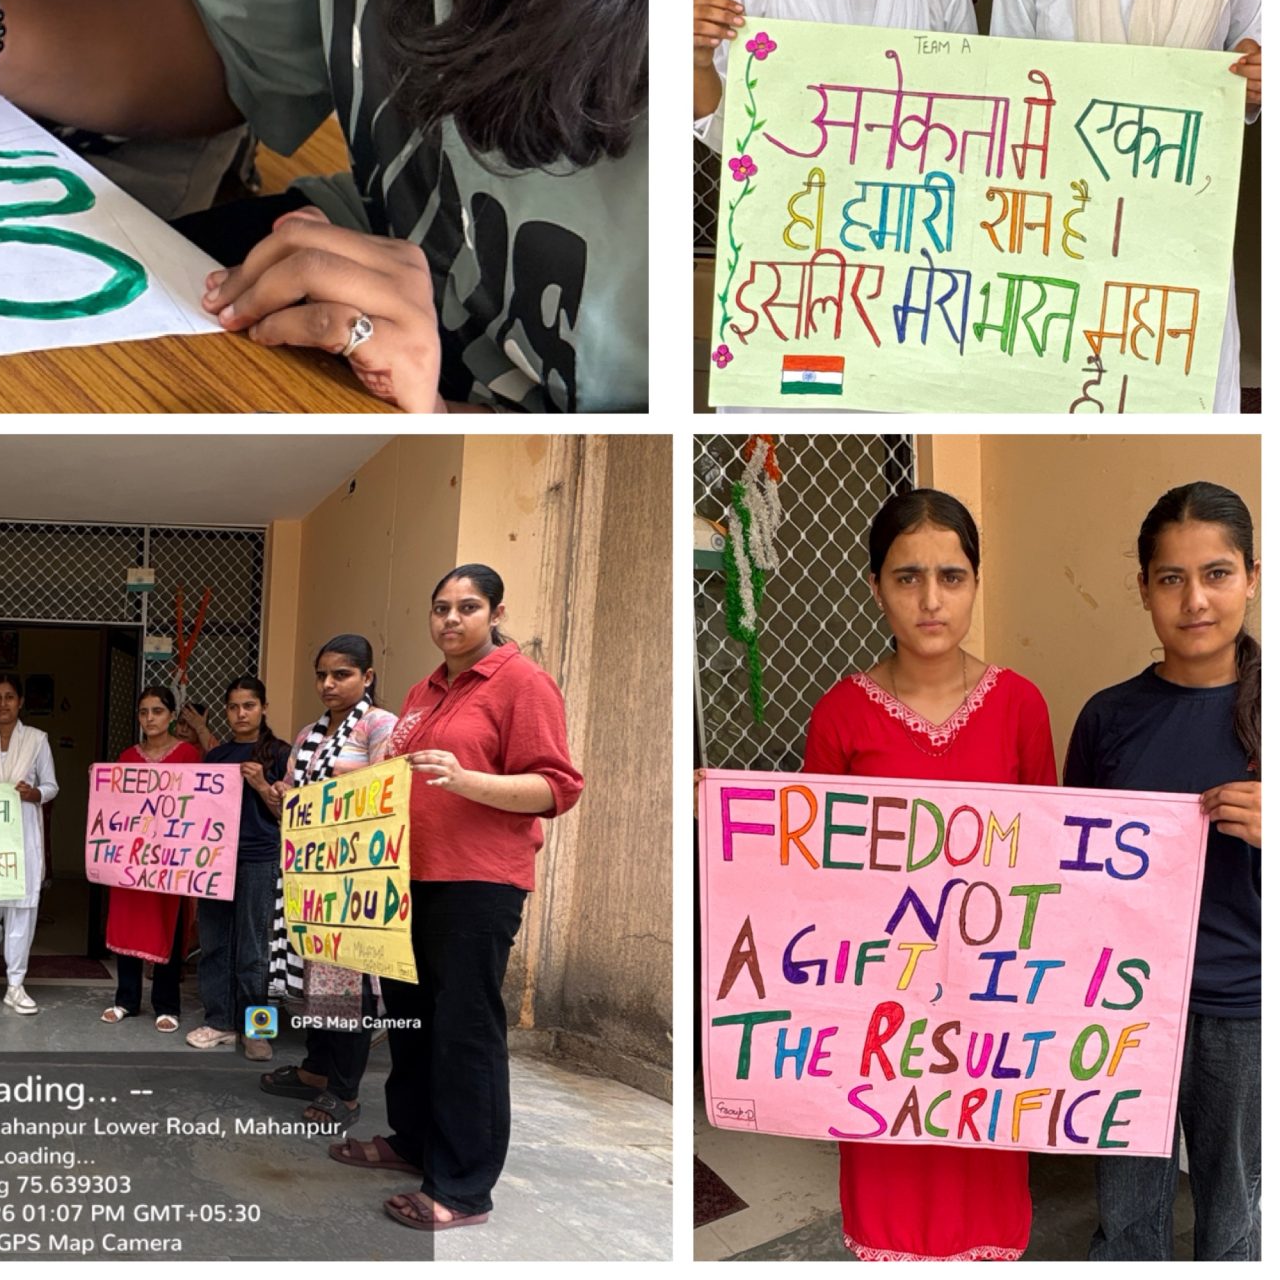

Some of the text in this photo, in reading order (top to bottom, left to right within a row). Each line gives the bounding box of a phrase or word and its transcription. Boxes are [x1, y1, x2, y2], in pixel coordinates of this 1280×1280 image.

[913, 35, 972, 55] TEAM A
[782, 166, 826, 251] ही
[839, 170, 956, 254] हमारी
[980, 186, 1053, 256] शान
[730, 248, 1200, 375] इसलिए मेरा भारत महान
[95, 767, 225, 795] FREEDOM IS
[284, 824, 405, 872] DEPENDS ON
[720, 784, 1152, 881] FREEDOM IS
[118, 866, 223, 896] SACRIFICE
[885, 878, 1061, 950] NOT
[292, 925, 342, 961] TODAY
[716, 915, 1151, 1011] A GIFT, IT IS
[712, 1001, 1150, 1081] THE RESULT OF
[829, 1083, 1142, 1149] SACRIFICE
